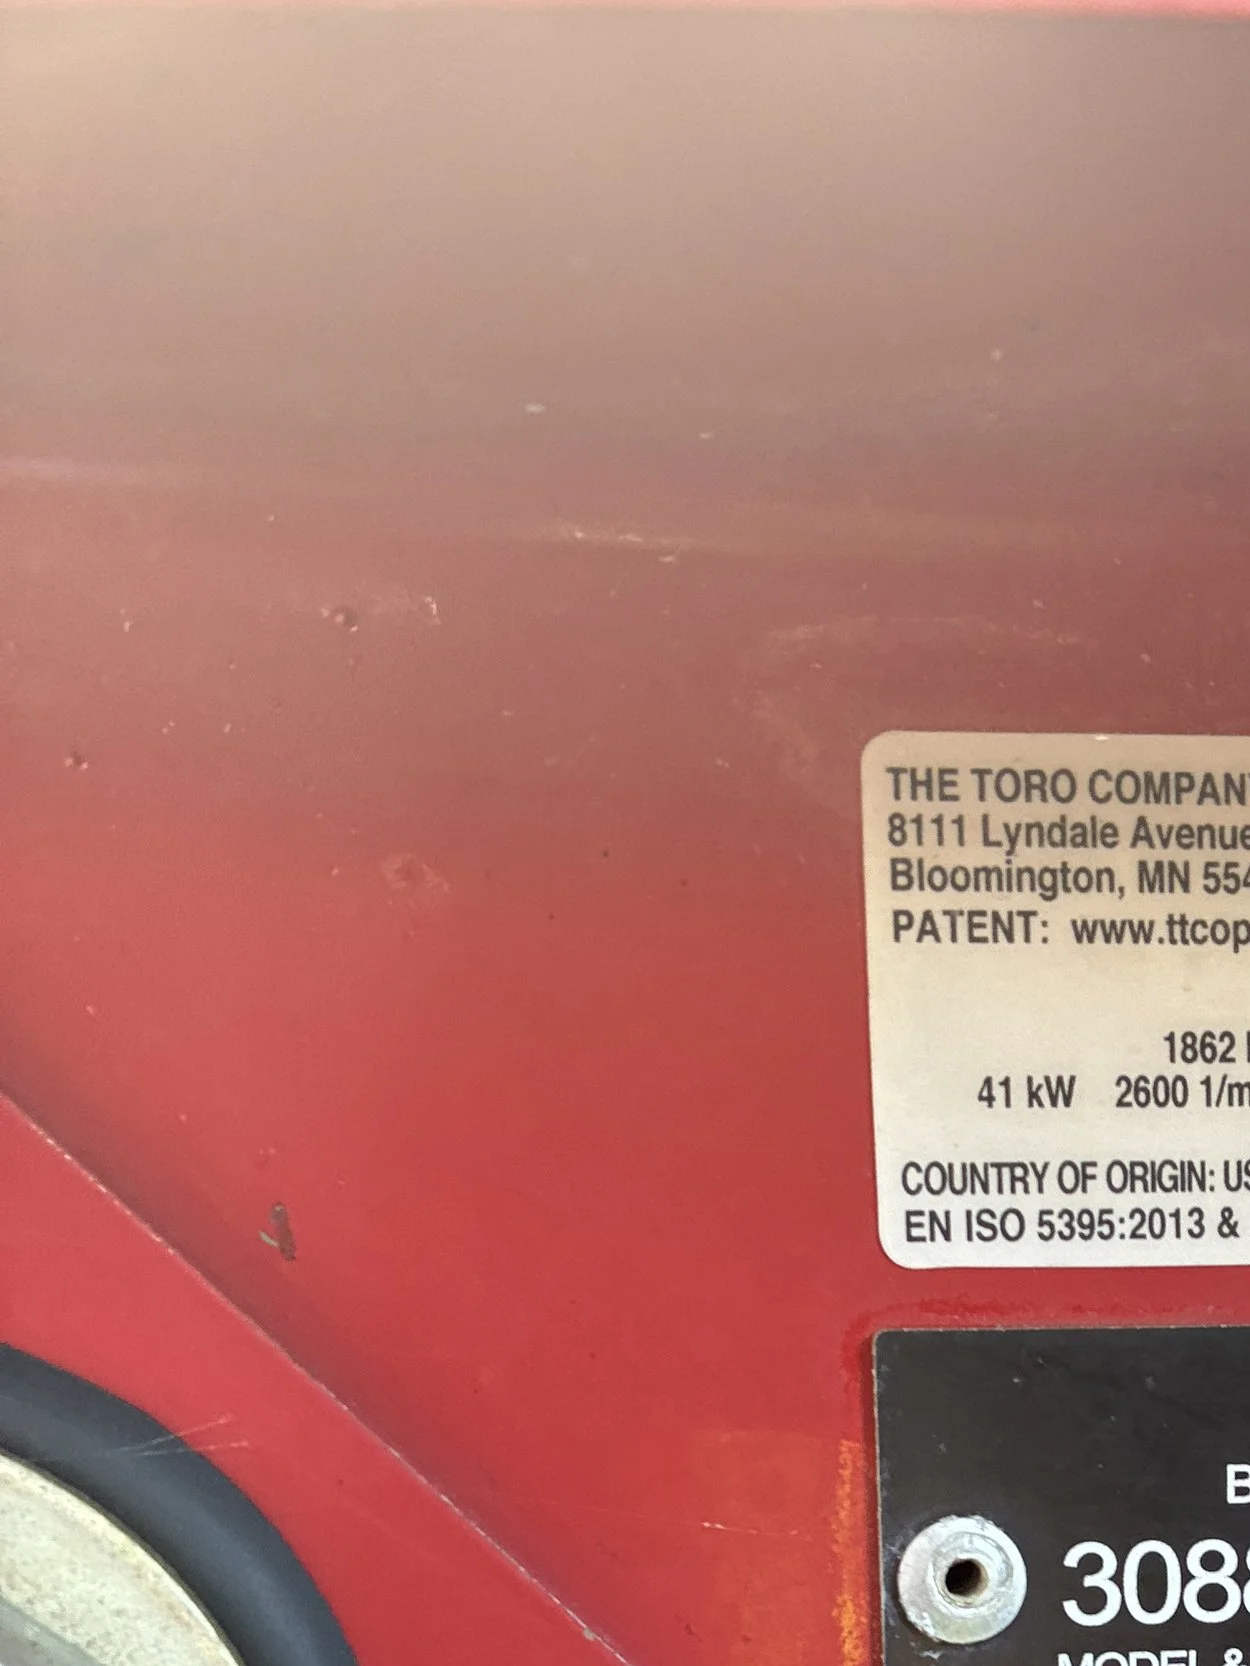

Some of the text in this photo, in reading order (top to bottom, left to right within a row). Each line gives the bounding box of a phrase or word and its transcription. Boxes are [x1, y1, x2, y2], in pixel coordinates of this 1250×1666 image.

[885, 766, 961, 802] THE
[970, 767, 1078, 805] TORO
[887, 811, 965, 848] 8111
[981, 813, 1120, 857] Lyndale
[889, 857, 1125, 902] Bloomington,
[1137, 859, 1191, 894] MN
[892, 909, 1049, 945] PATENT:
[1163, 1030, 1237, 1065] 1862
[977, 1075, 1012, 1109] 41
[1026, 1074, 1077, 1109] kW
[1115, 1074, 1189, 1109] 2600
[901, 1160, 1050, 1196] COUNTRY
[1057, 1159, 1098, 1195] OF
[1105, 1159, 1215, 1195] ORIGIN:
[905, 1209, 952, 1243] EN
[965, 1207, 1026, 1243] ISO
[1037, 1206, 1206, 1242] 5395:2013
[1217, 1206, 1240, 1239] &
